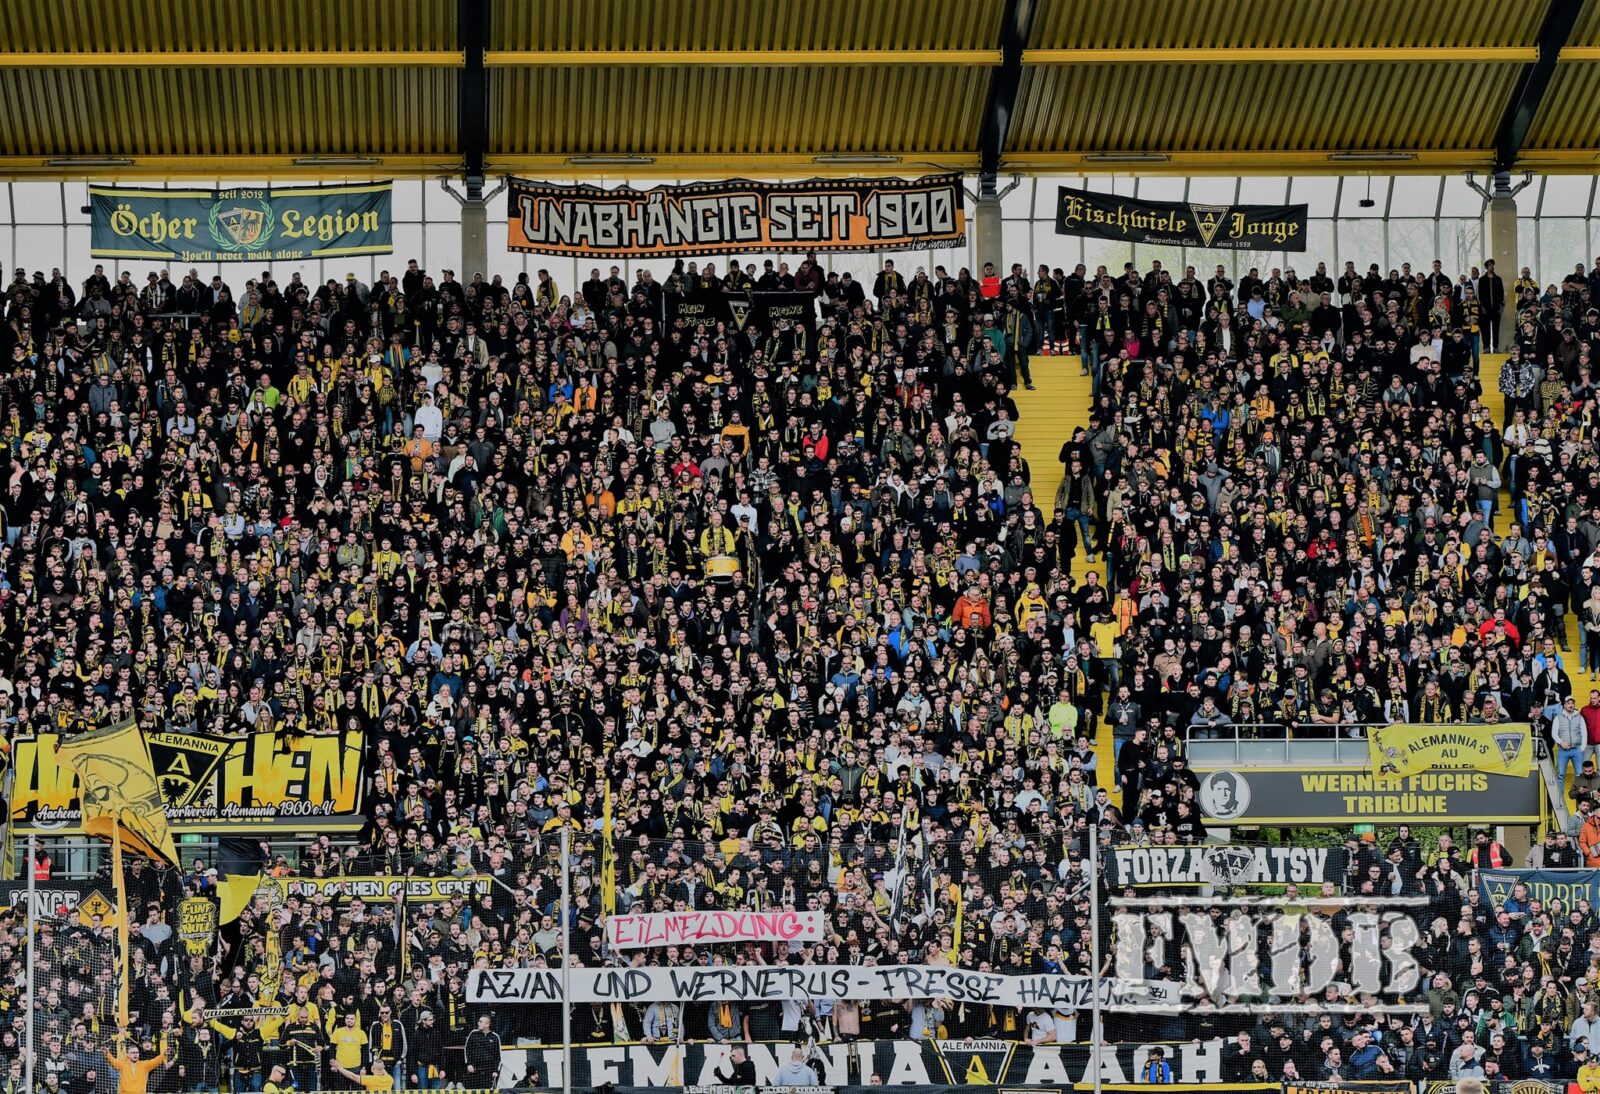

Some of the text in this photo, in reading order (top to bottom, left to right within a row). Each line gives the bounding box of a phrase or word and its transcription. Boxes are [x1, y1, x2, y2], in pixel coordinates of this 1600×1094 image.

[240, 190, 264, 199] 2012
[110, 203, 380, 244] Öcher Legion
[520, 187, 955, 245] UNABHÄNGIG SEIT 1900
[1229, 212, 1299, 245] Jonge
[215, 251, 244, 261] never
[247, 250, 271, 261] walk
[274, 249, 303, 260] alone
[149, 732, 219, 752] ALEMANNIA
[1440, 748, 1458, 758] AU
[167, 752, 191, 776] A
[1301, 773, 1489, 793] WERNER FUCHS
[221, 802, 276, 818] Alemannia
[1342, 793, 1448, 814] TRIBÜNE
[1114, 847, 1328, 885] FORZA ATSV
[593, 970, 651, 998] UND
[236, 1006, 289, 1016] CONNECTION
[941, 1042, 1008, 1052] ALEMANNIA
